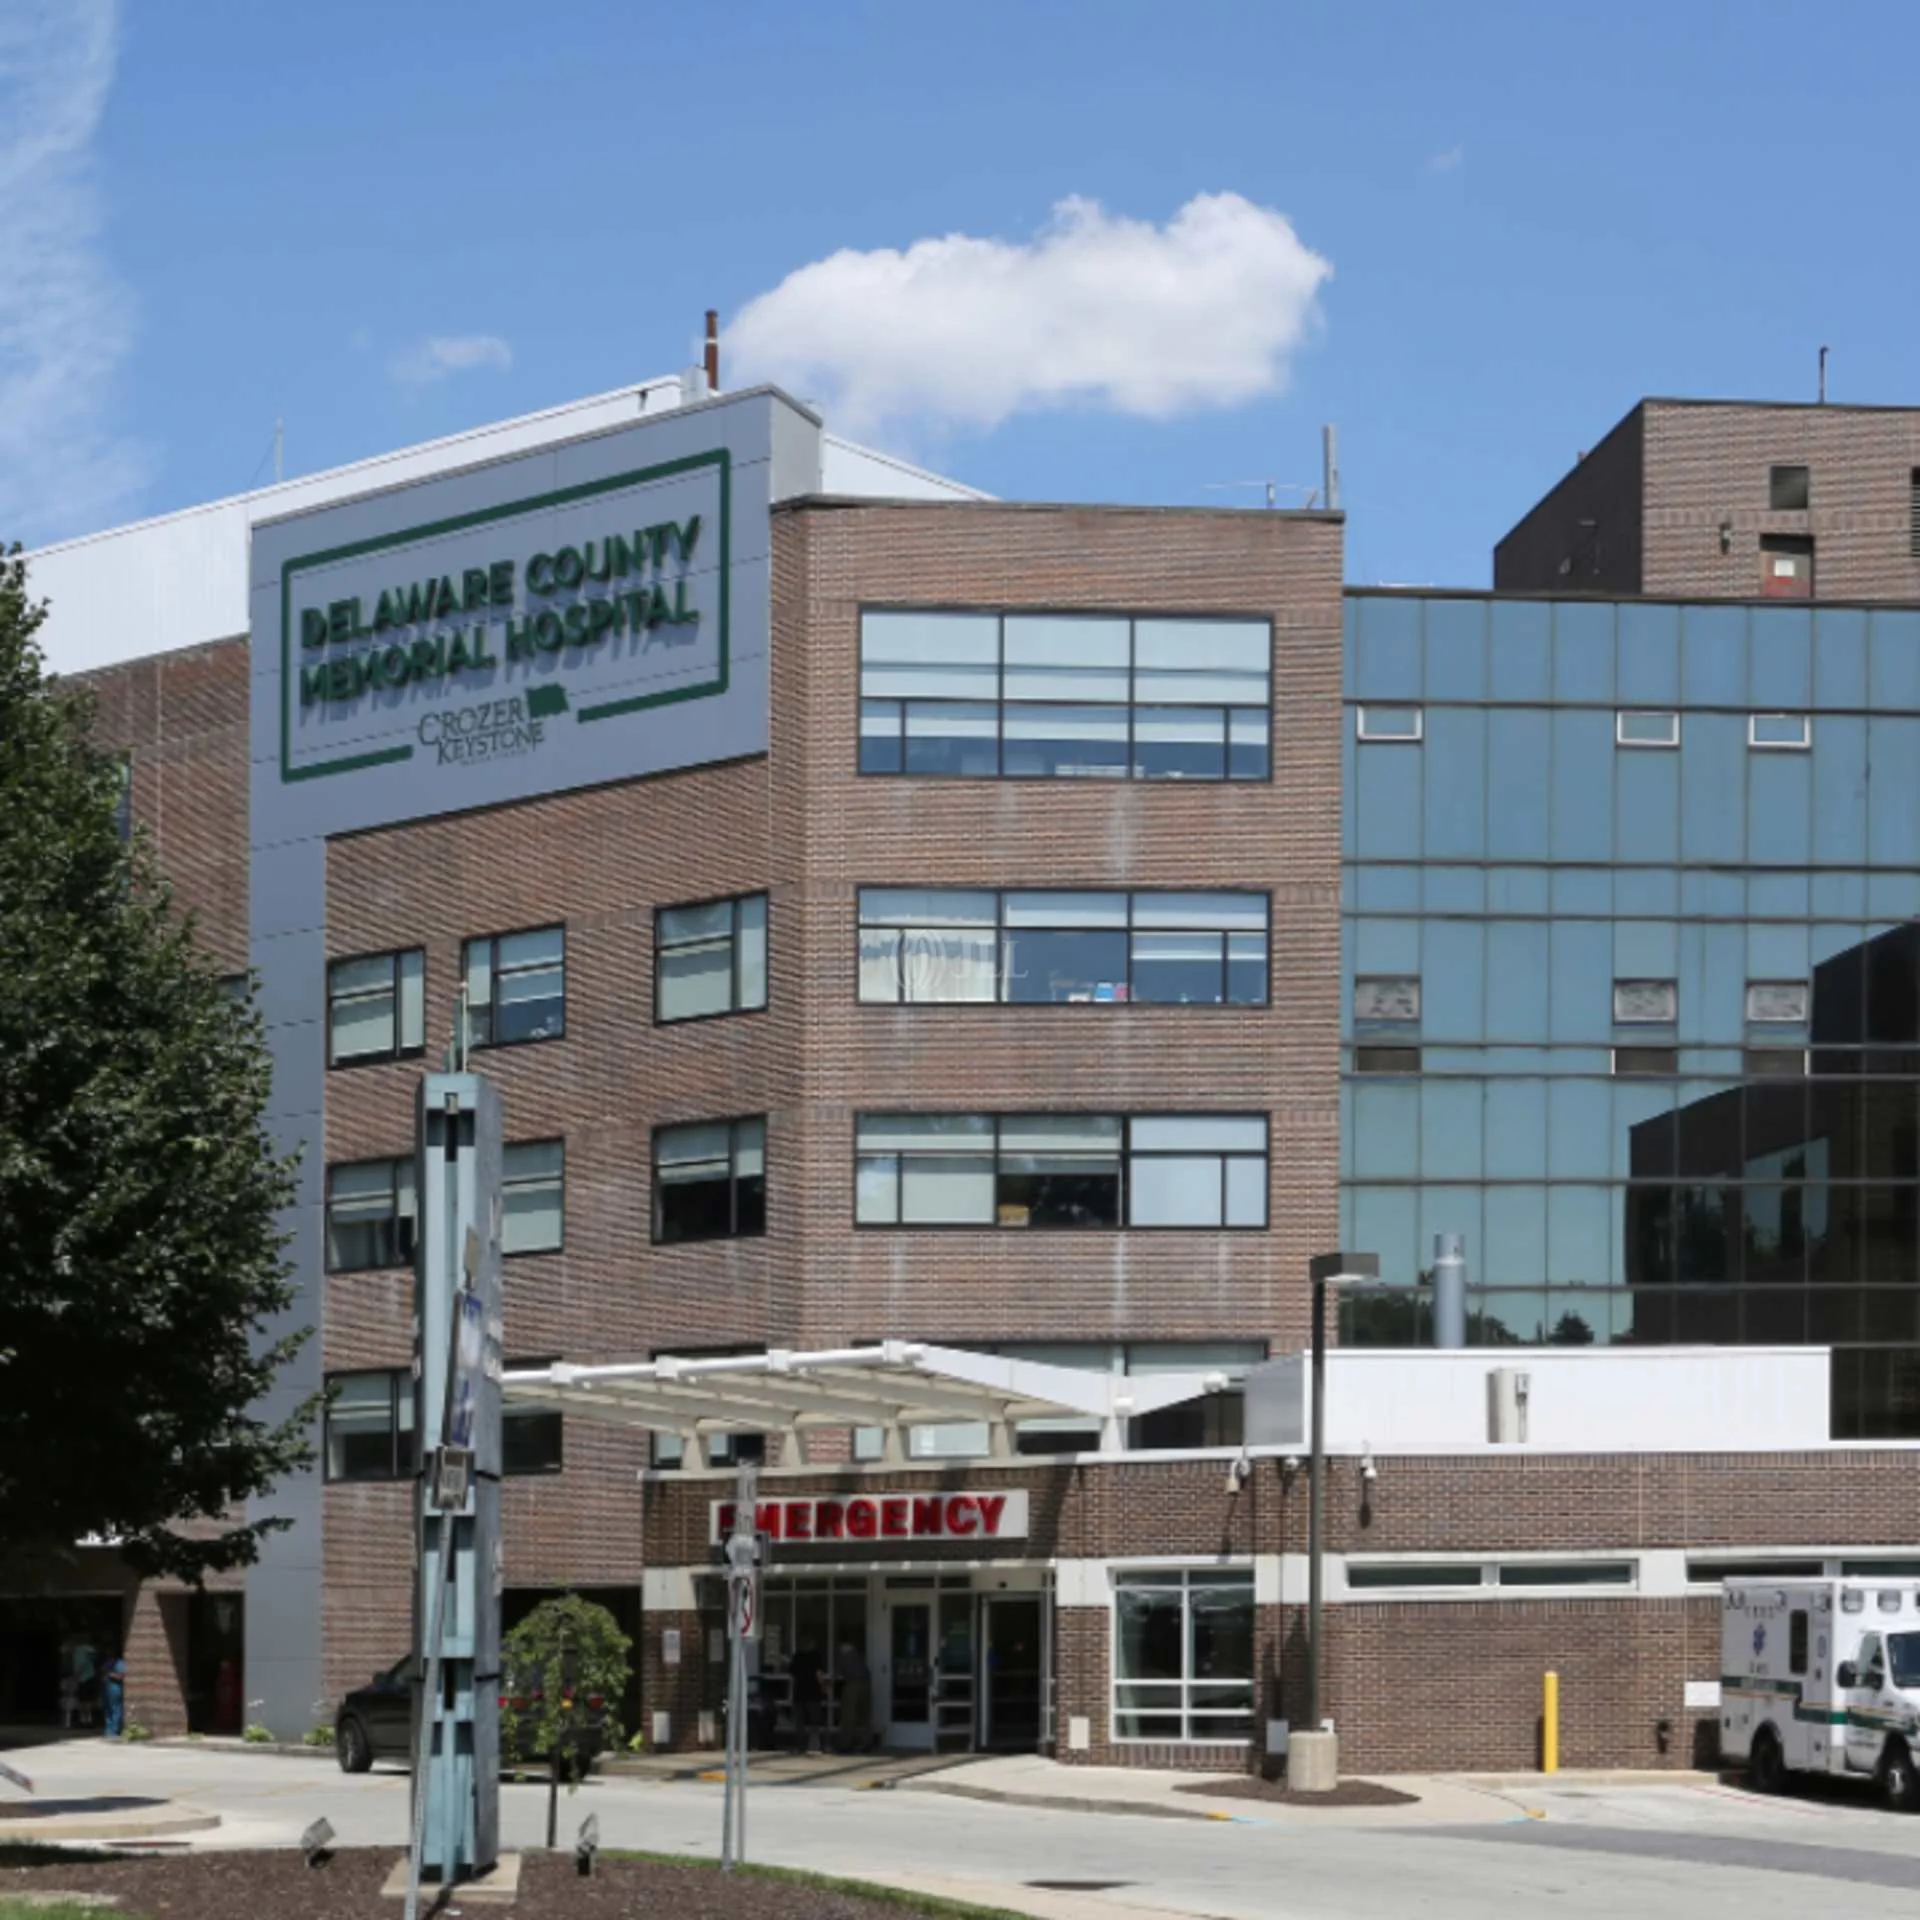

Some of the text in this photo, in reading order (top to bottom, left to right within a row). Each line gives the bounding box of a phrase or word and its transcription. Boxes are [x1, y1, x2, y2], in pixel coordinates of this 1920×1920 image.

[302, 514, 701, 648] DELAWARE COUNTY
[301, 579, 700, 707] MEMORIAL HOSPITAL
[417, 697, 525, 746] CROZER
[437, 719, 546, 766] KEYSTONE
